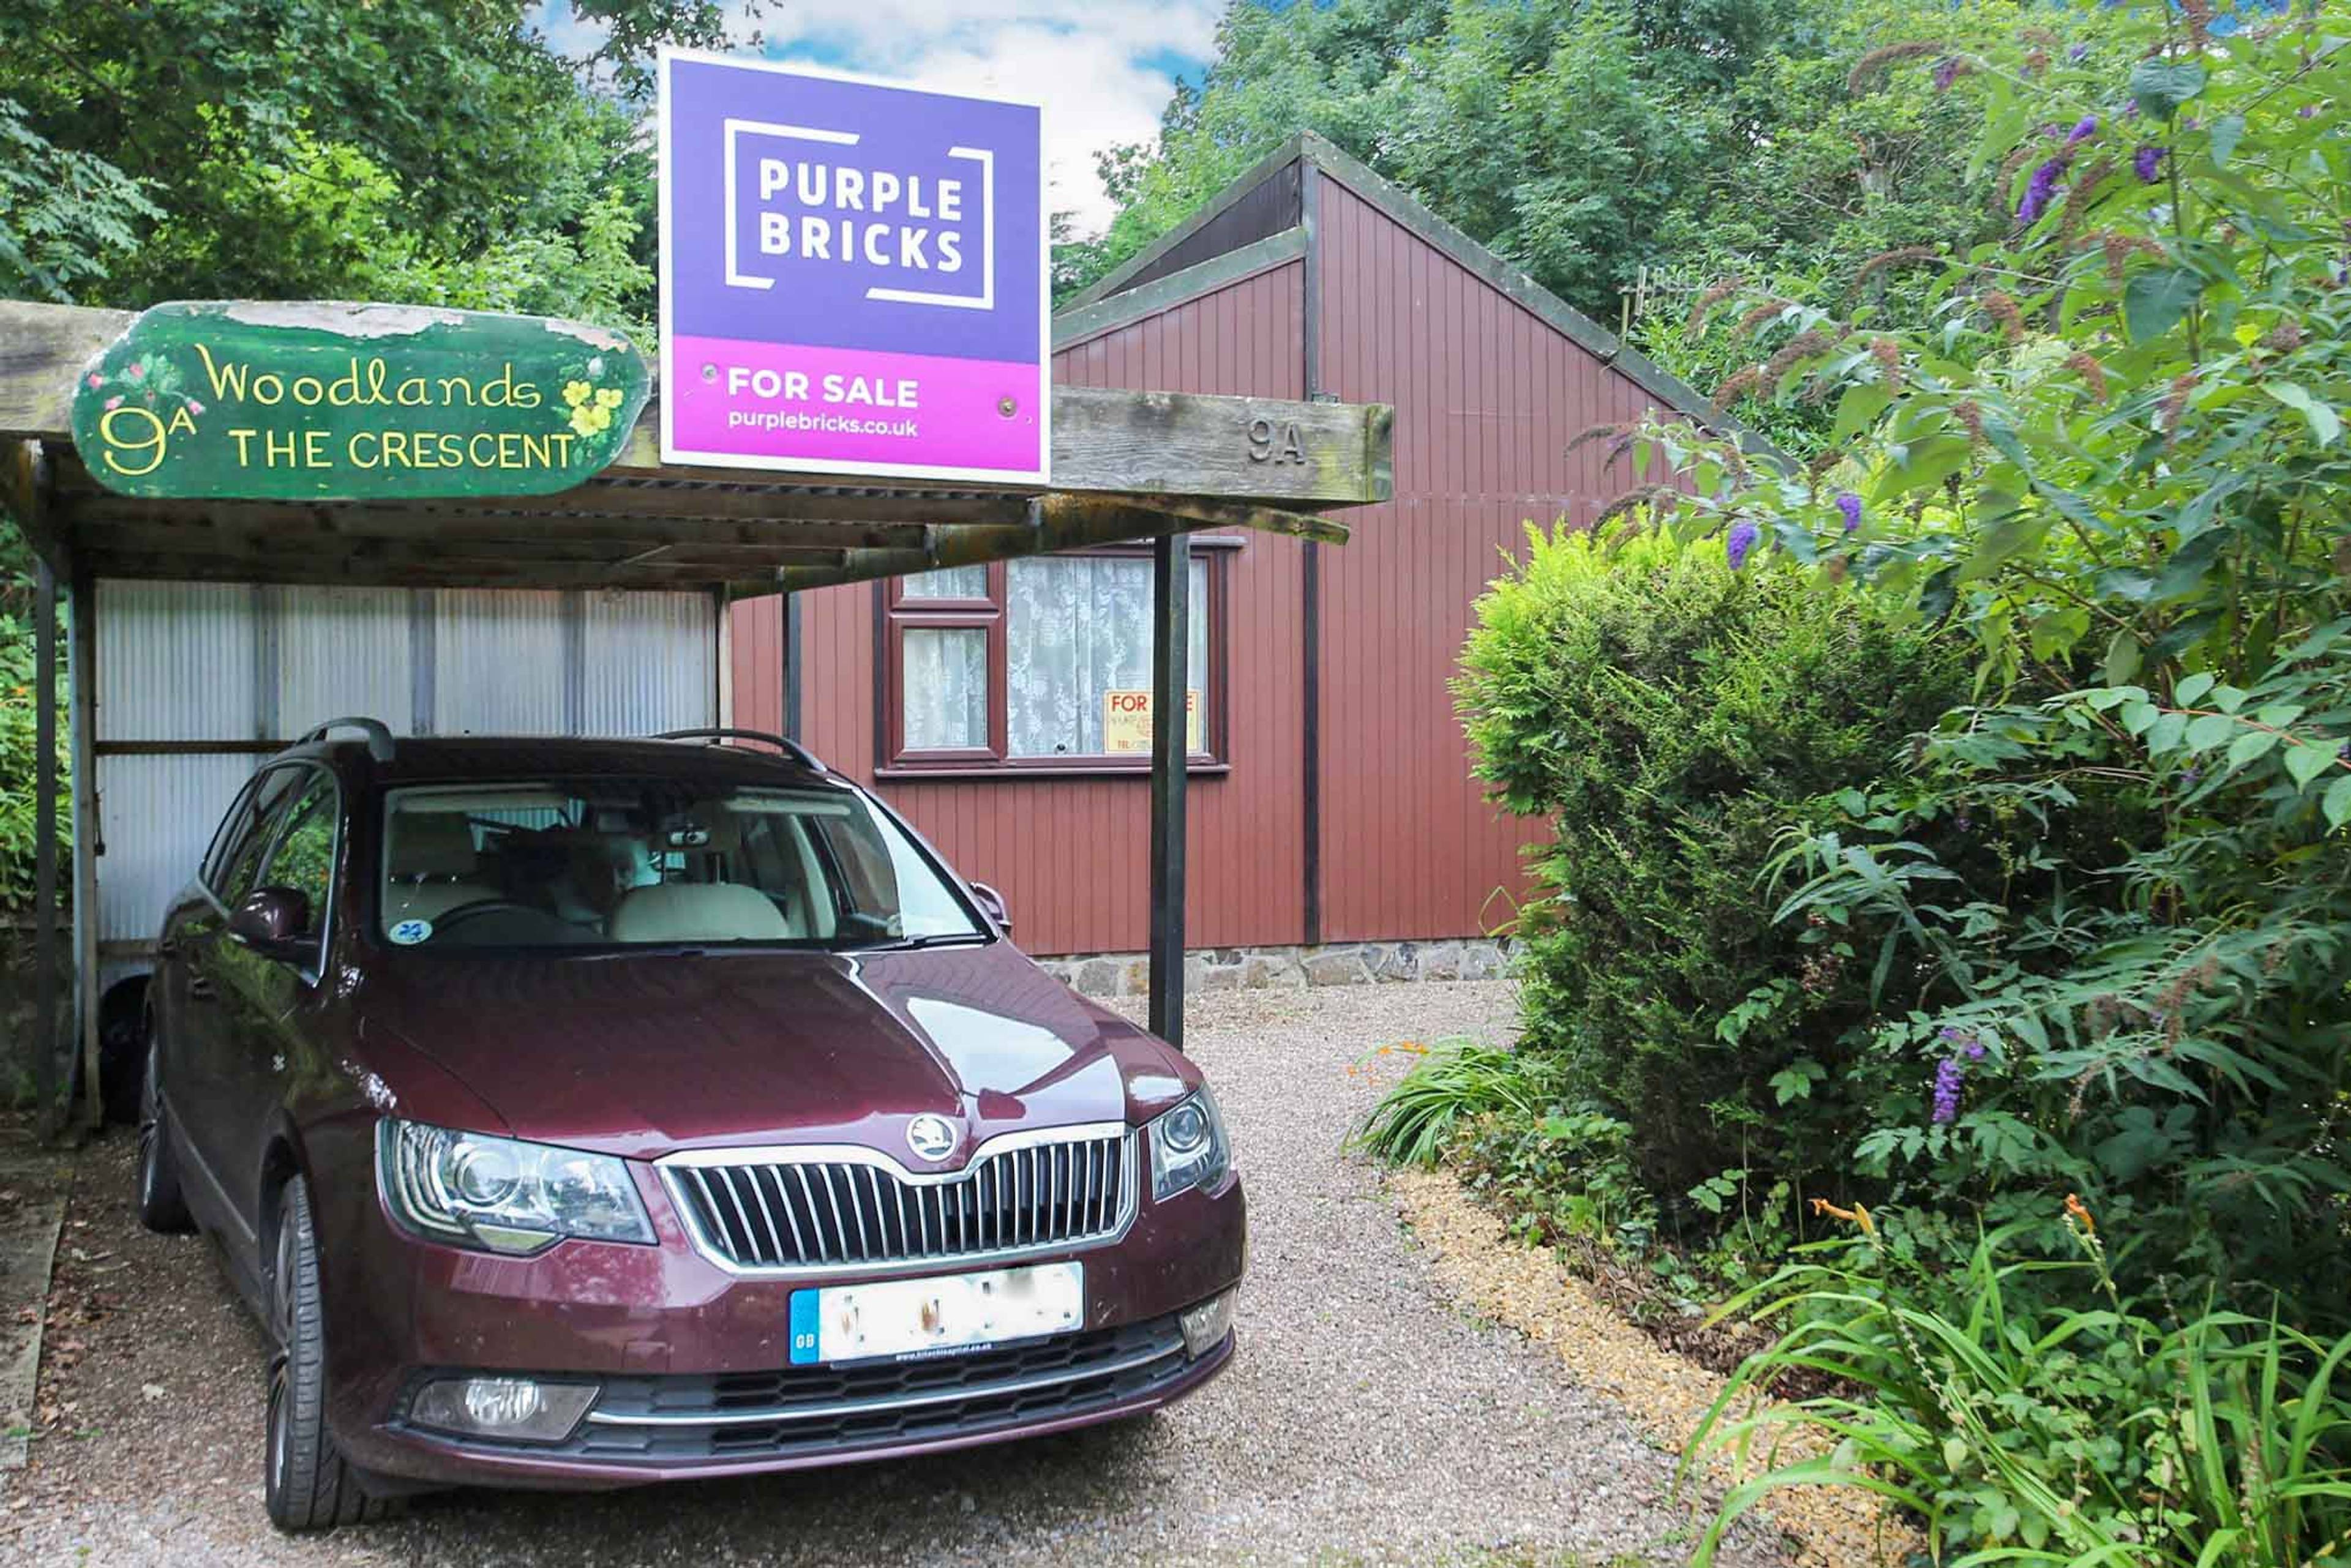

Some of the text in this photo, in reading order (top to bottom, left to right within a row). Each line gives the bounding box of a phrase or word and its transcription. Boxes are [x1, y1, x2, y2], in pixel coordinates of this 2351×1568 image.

[759, 157, 962, 221] PURPLE
[760, 211, 962, 273] BRICKS
[195, 342, 542, 408] Woodlands
[727, 367, 918, 408] FOR SALE
[728, 410, 918, 438] purplebricks.co.uk
[1248, 417, 1305, 464] 9A
[228, 429, 332, 469] THE
[348, 432, 576, 469] CRESCENT
[1111, 695, 1147, 713] FOR
[796, 1334, 814, 1349] GB
